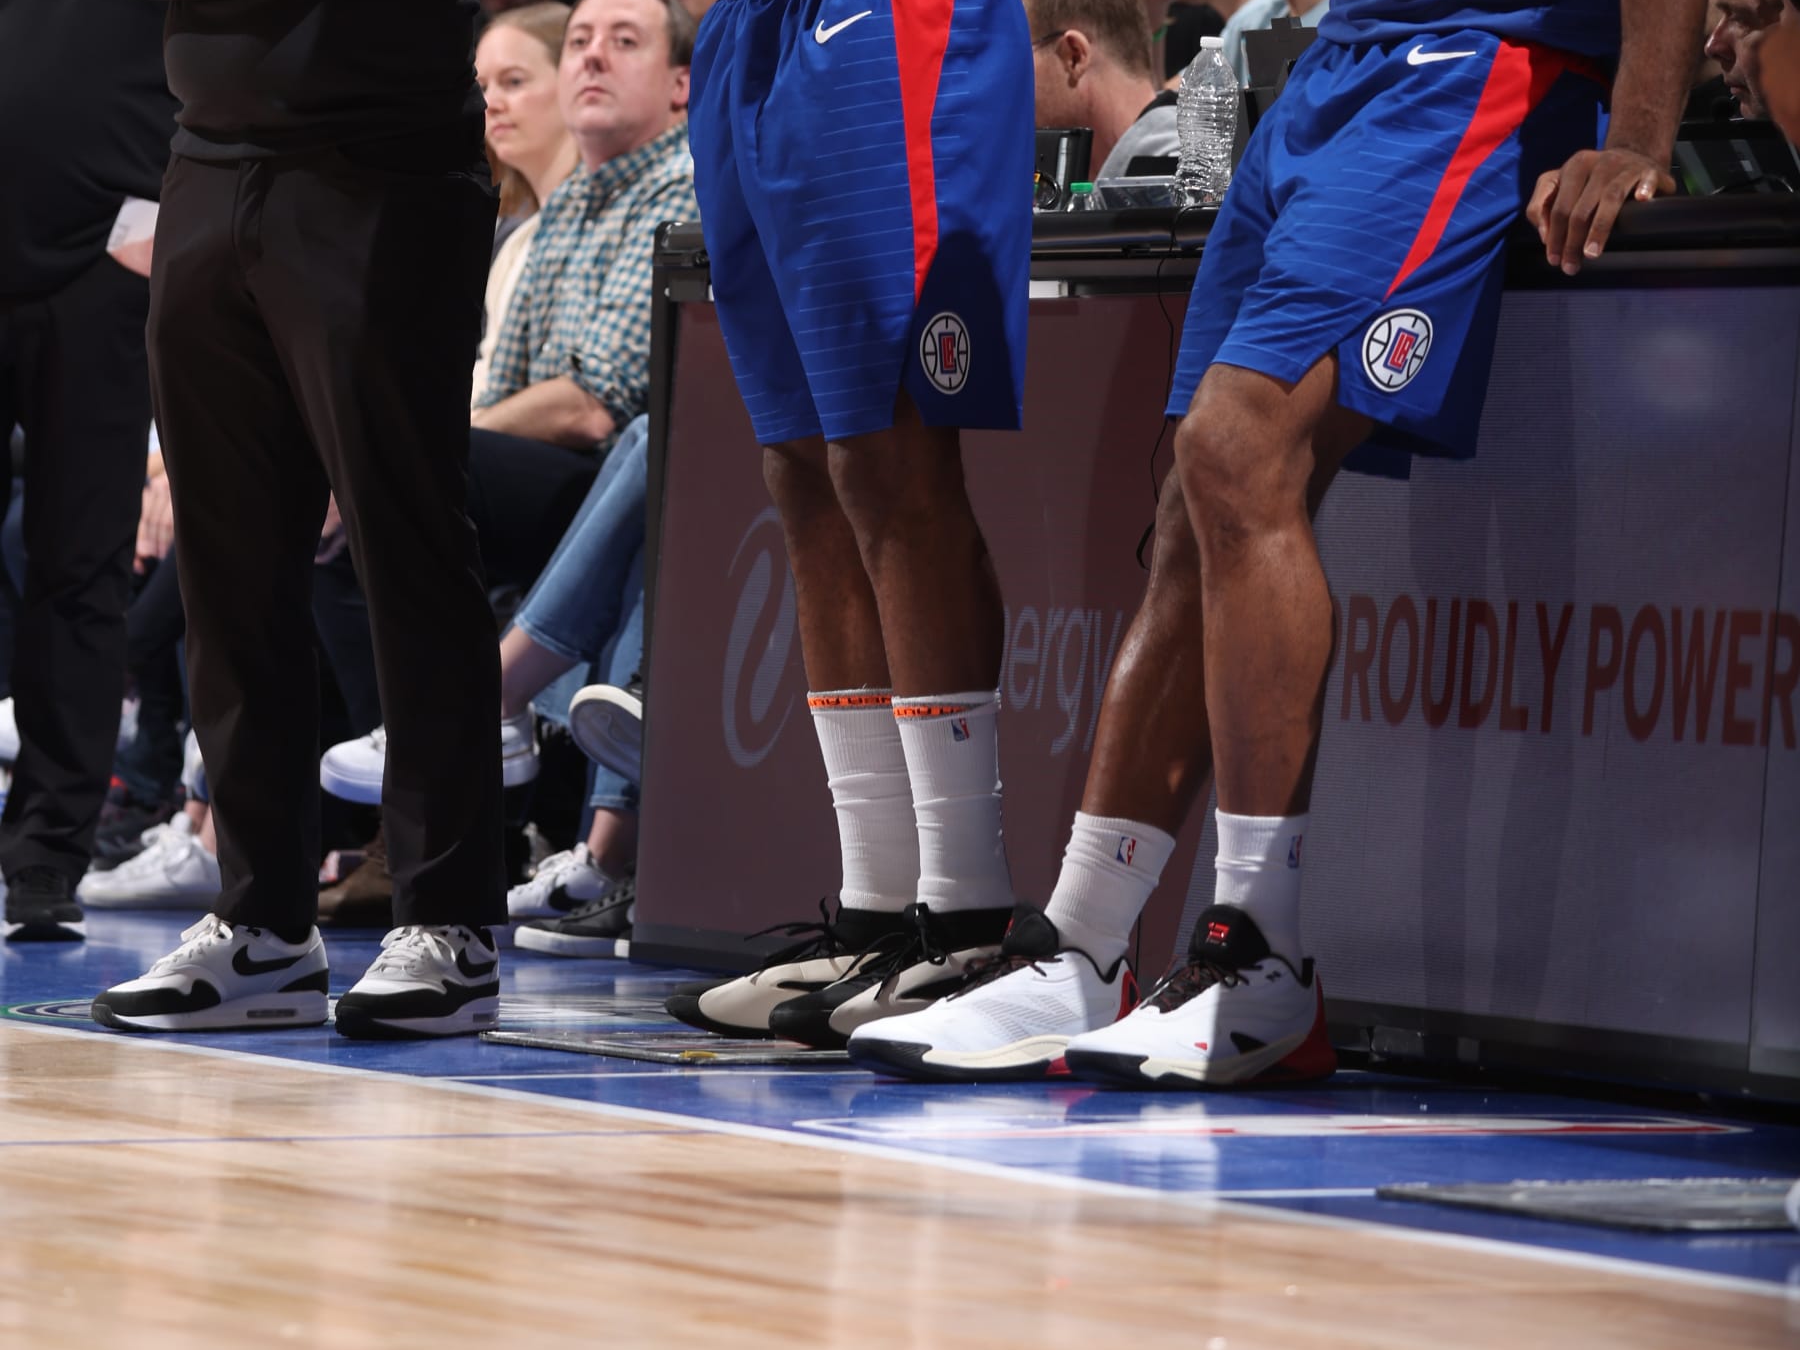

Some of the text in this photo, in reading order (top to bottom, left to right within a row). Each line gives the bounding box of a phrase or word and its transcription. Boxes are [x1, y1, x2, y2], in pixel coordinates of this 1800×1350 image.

[1001, 604, 1124, 756] ergy
[1332, 593, 1800, 750] ROUDLY POWER
